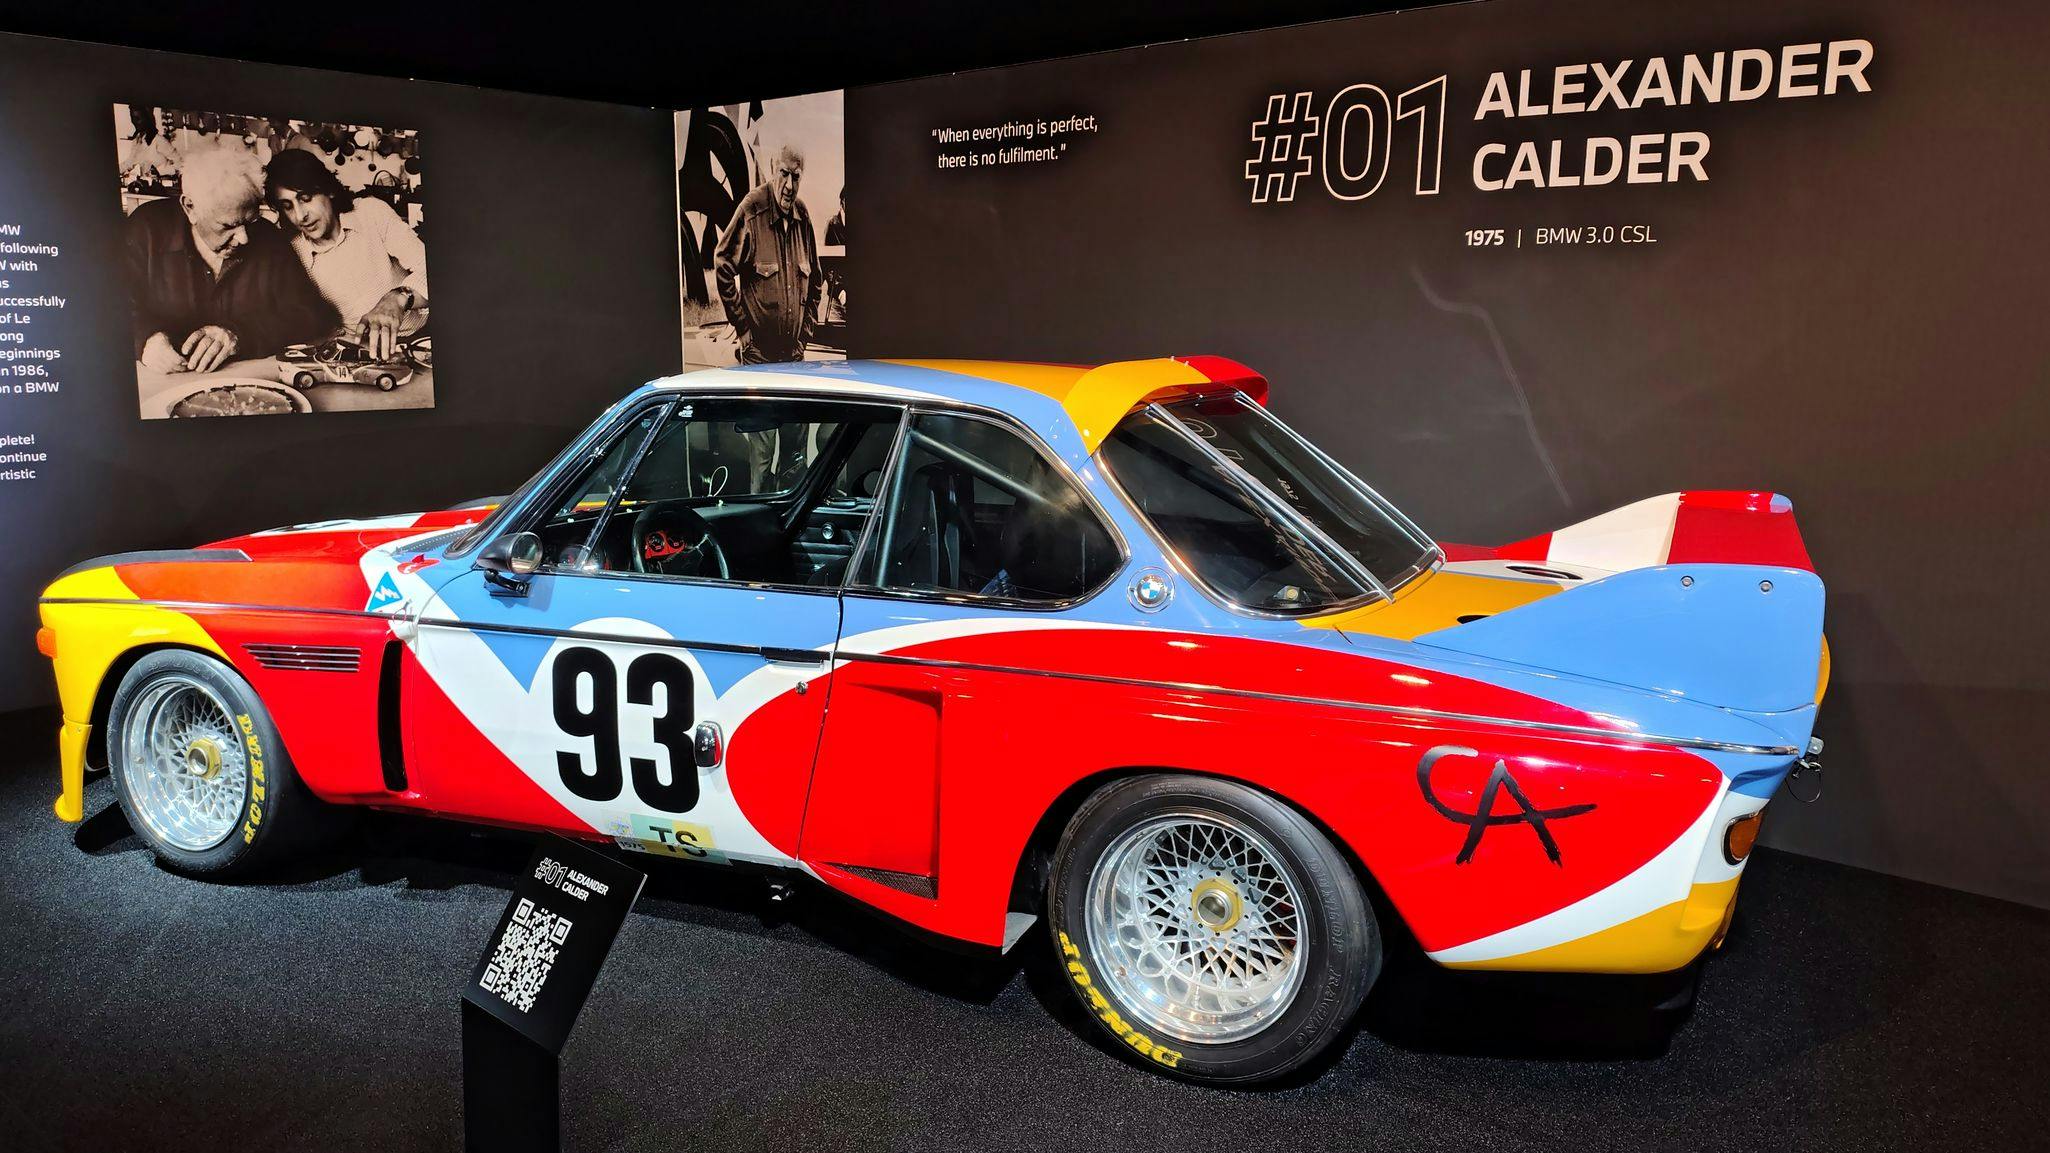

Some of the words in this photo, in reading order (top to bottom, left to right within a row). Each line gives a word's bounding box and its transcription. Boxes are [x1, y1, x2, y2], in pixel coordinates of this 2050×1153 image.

[1474, 39, 1874, 121] ALEXANDER
[973, 120, 1034, 142] everything
[1036, 119, 1047, 134] is
[1050, 115, 1098, 137] perfect,
[1245, 75, 1447, 203] #01
[938, 153, 967, 169] there
[969, 151, 979, 167] is
[981, 153, 996, 166] no
[1473, 131, 1711, 192] CALDER
[0, 225, 21, 236] MW
[1465, 229, 1505, 246] 1975
[1536, 227, 1583, 245] BMW
[1586, 226, 1614, 244] 3.0
[1620, 225, 1658, 243] CSL
[0, 242, 60, 257] following
[9, 260, 38, 272] with
[0, 296, 66, 309] ccessfully
[14, 313, 31, 324] Le
[0, 332, 24, 344] ong
[0, 348, 61, 361] eginnings
[0, 367, 10, 377] n
[12, 365, 49, 378] 1986,
[14, 385, 22, 394] a
[25, 382, 60, 394] BMW
[0, 434, 35, 448] plete!
[0, 452, 47, 463] ontinue
[0, 469, 36, 481] rtistic
[552, 646, 700, 813] 93
[648, 825, 708, 858] TS
[534, 857, 569, 889] #01
[566, 869, 609, 896] ALEXANDER
[561, 881, 590, 902] CALDER
